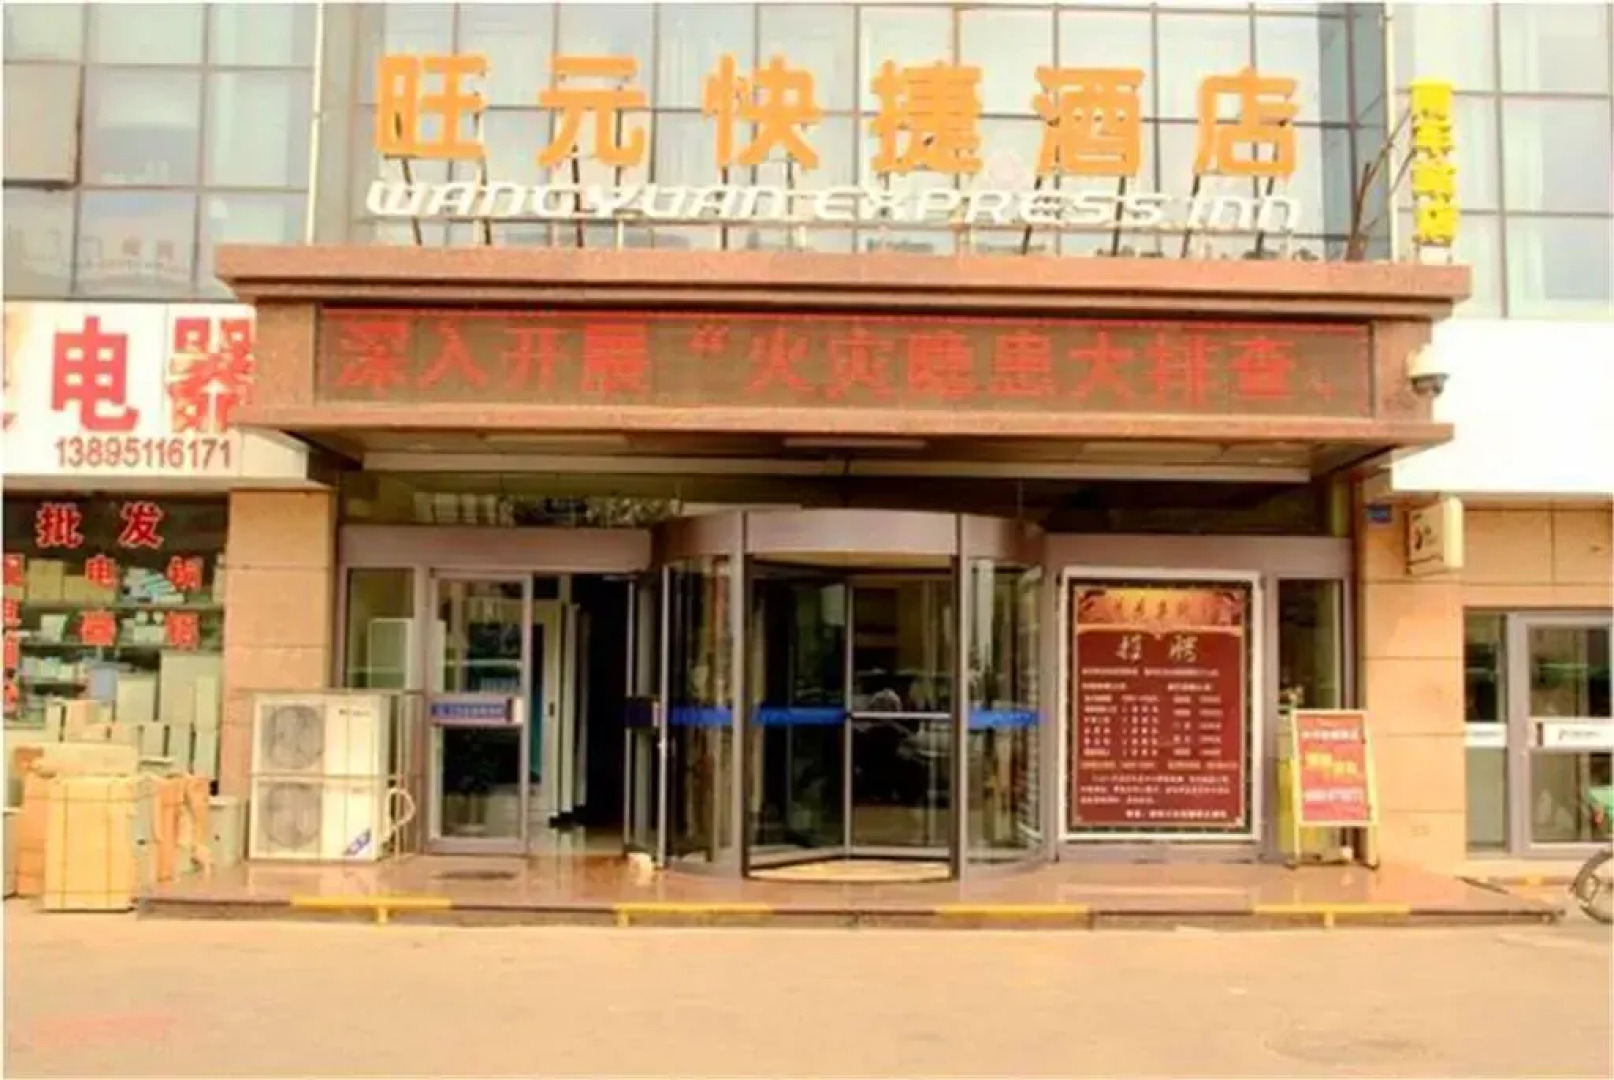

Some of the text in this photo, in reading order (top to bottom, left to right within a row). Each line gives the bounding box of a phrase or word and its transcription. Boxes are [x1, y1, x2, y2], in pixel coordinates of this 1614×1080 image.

[374, 52, 1304, 178] 旺元快捷酒店
[55, 436, 233, 469] 13895116171
[35, 501, 165, 549] 批发
